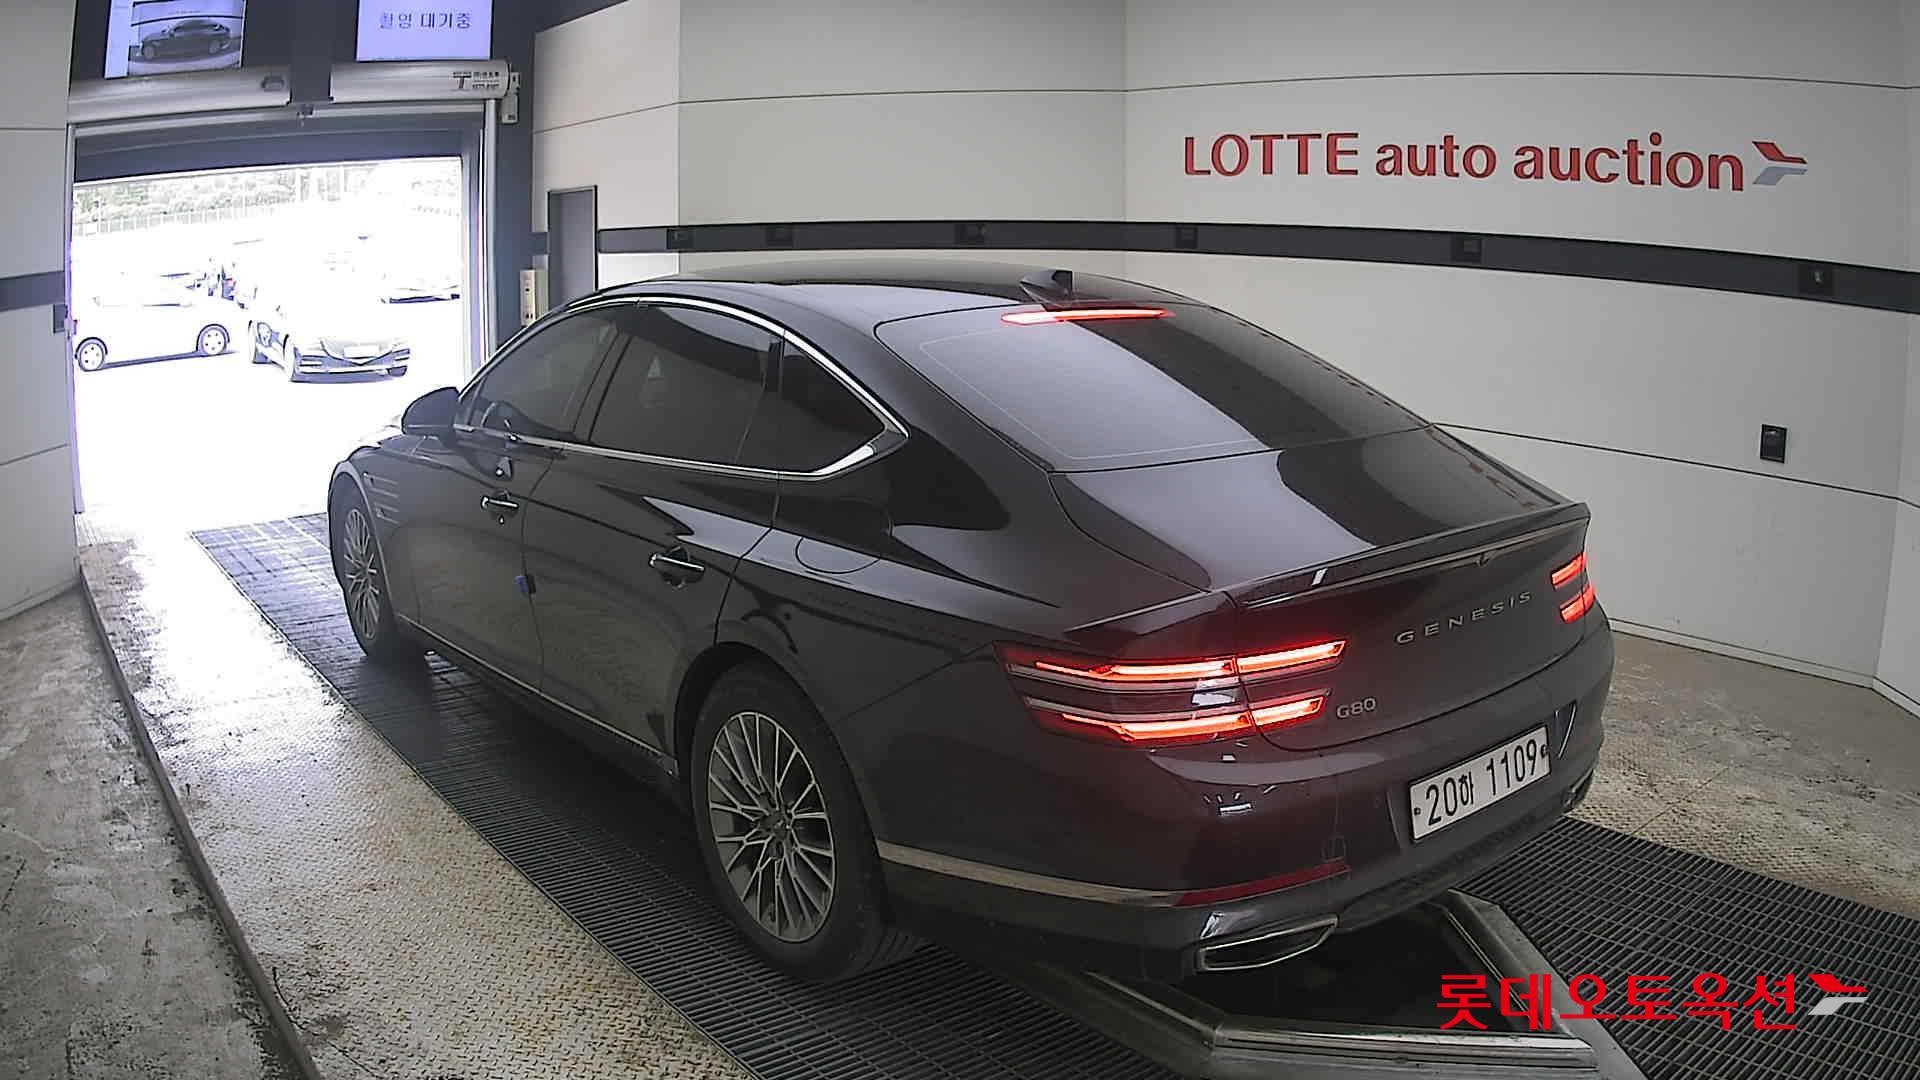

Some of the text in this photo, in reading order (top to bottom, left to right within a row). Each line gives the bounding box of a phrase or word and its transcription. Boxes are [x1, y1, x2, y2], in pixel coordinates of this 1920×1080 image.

[420, 12, 471, 29] 대기중
[1184, 132, 1744, 192] LOTTE auto auction
[1394, 591, 1532, 644] GENESIS
[1336, 697, 1377, 719] G80
[1426, 738, 1538, 826] 20하 1109
